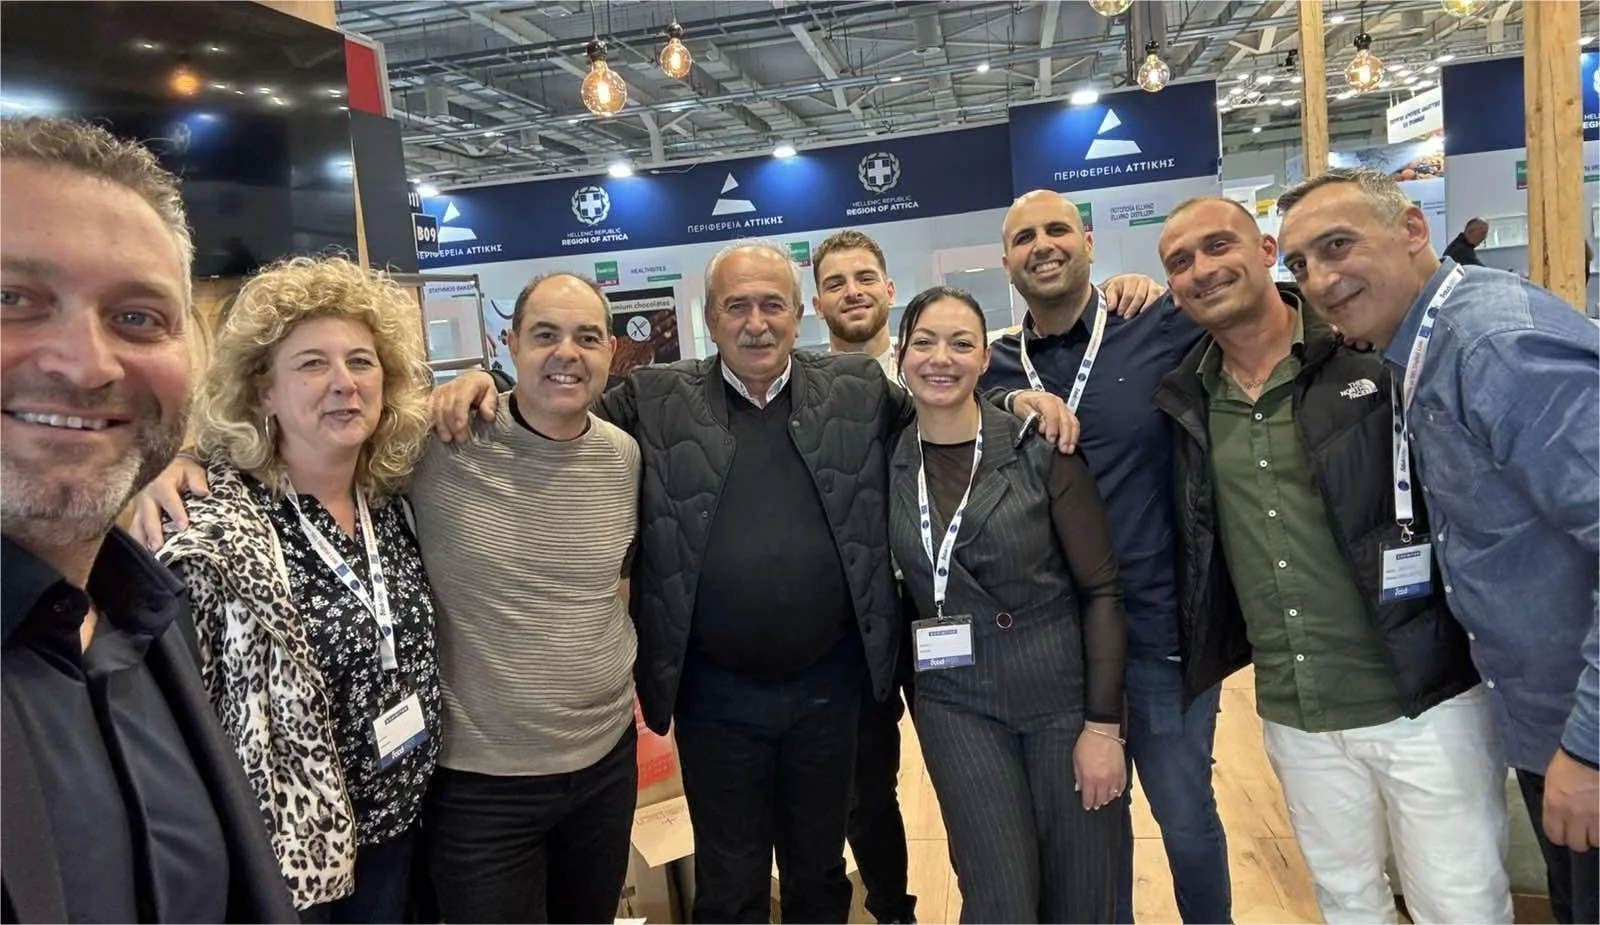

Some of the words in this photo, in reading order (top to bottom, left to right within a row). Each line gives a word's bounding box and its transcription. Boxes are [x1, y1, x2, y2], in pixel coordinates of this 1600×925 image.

[1054, 165, 1122, 181] ΠΕΡΙΦΕΡΕΙΑ
[1125, 158, 1176, 173] ΑΤΤΙΚΗΣ
[846, 206, 877, 216] REGION
[877, 204, 889, 212] OF
[890, 201, 919, 211] ATTICA
[687, 221, 742, 233] ΠΕΡΙΦΕΡΕΙΑ
[744, 216, 784, 227] ΑΤΤΙΚΗΣ
[416, 226, 436, 242] B09
[561, 237, 589, 246] REGION
[602, 233, 629, 242] ATTICA
[466, 244, 503, 255] ΑΤΤΙΚΗΣ
[634, 299, 670, 309] chocolates
